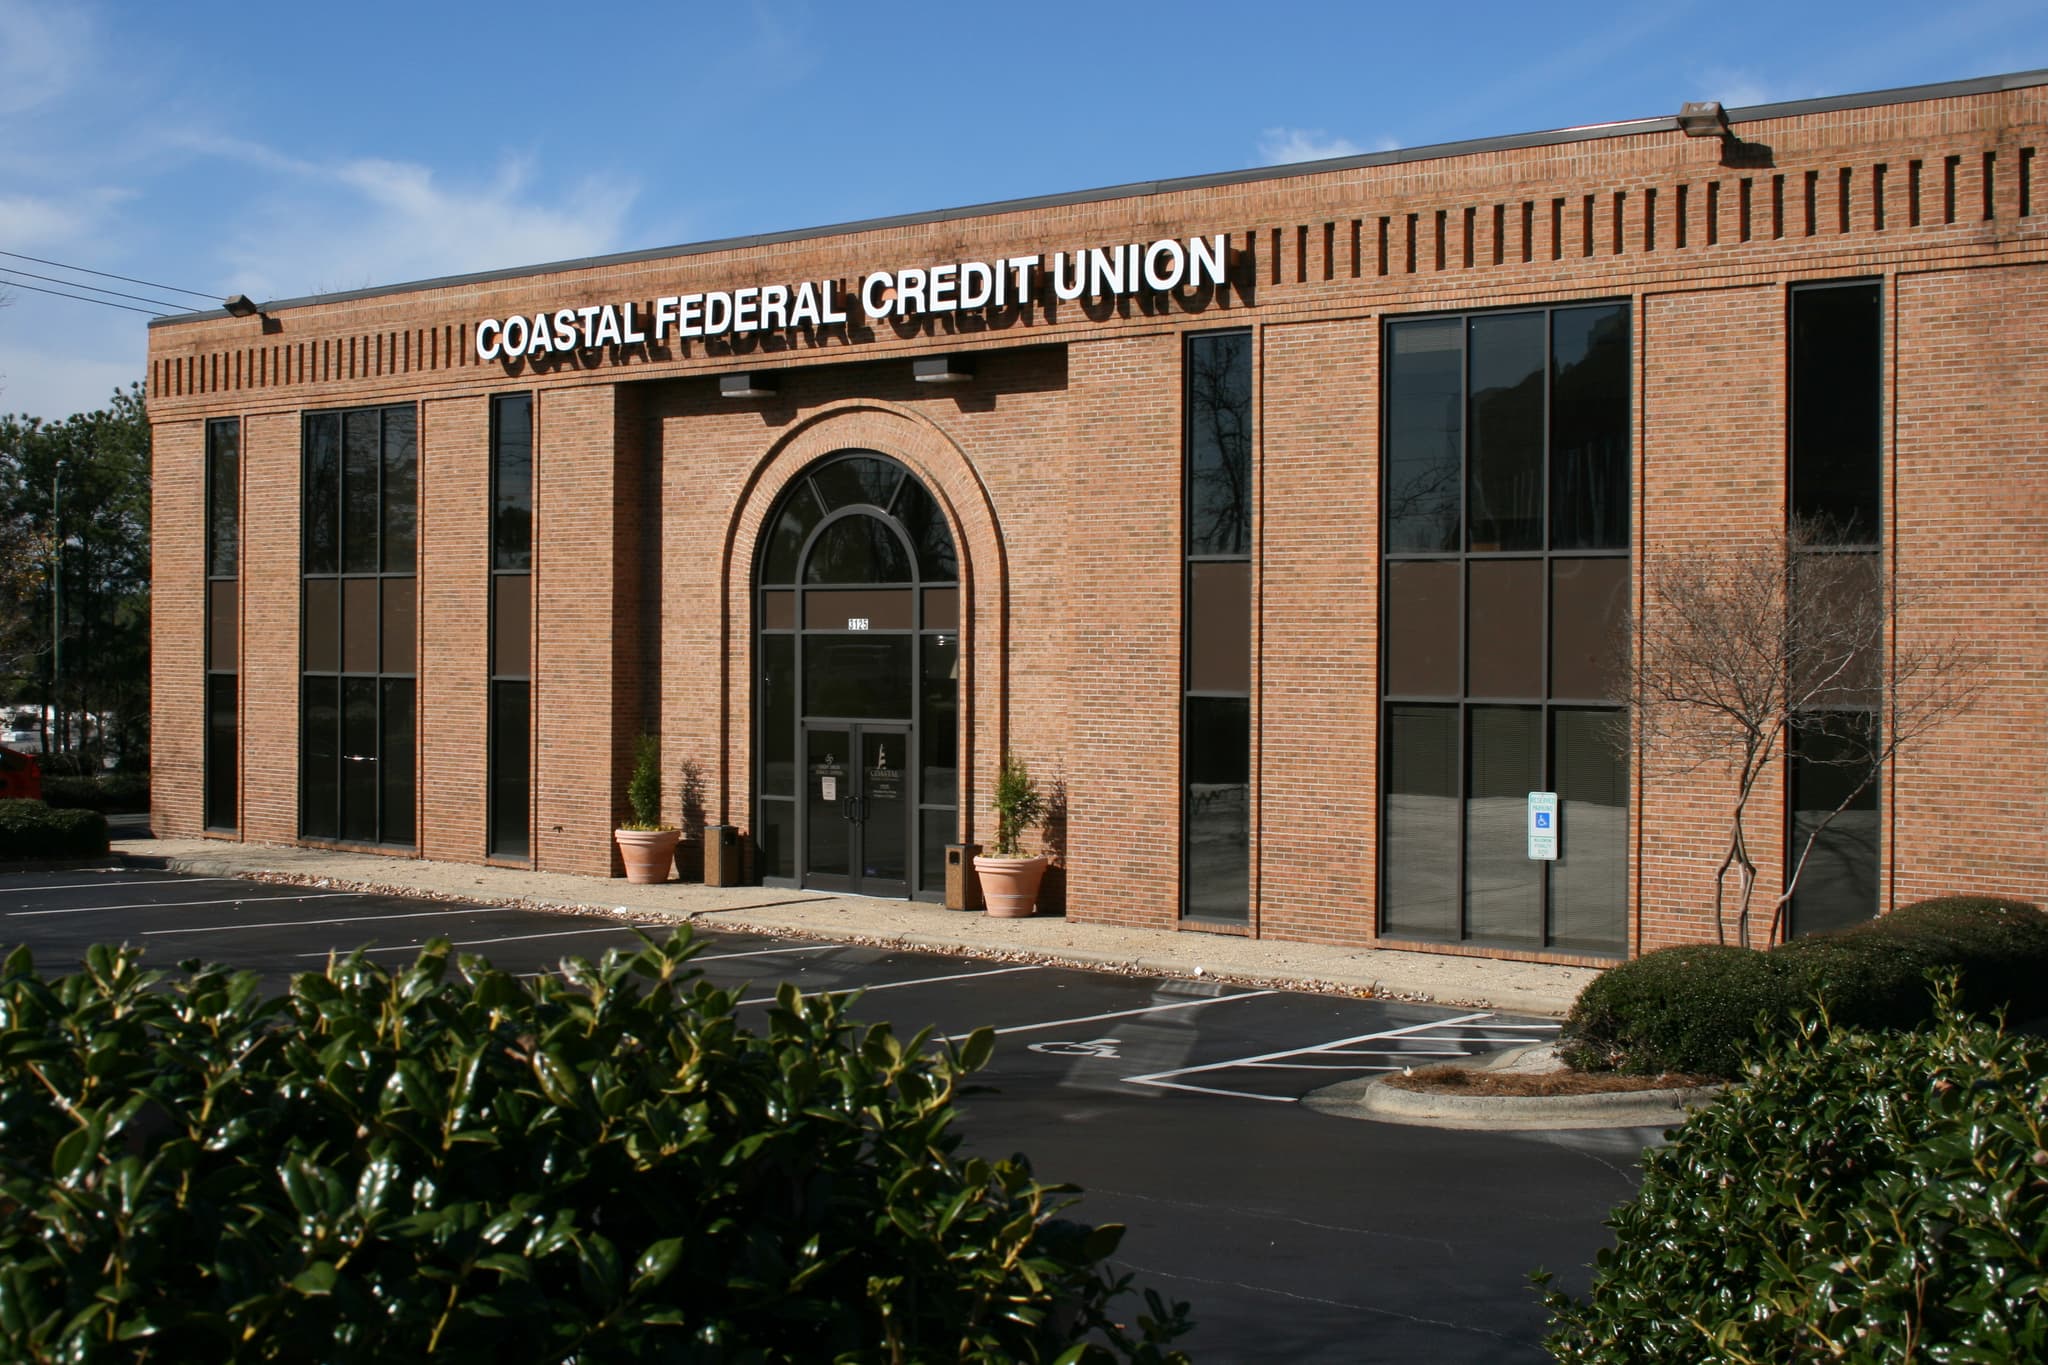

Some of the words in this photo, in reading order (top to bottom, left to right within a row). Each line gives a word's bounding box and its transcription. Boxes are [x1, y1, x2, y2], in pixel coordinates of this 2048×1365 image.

[475, 302, 647, 361] COASTAL
[654, 279, 847, 339] FEDERAL
[861, 255, 1040, 319] CREDIT
[1053, 234, 1226, 301] UNION
[848, 618, 869, 631] 3125
